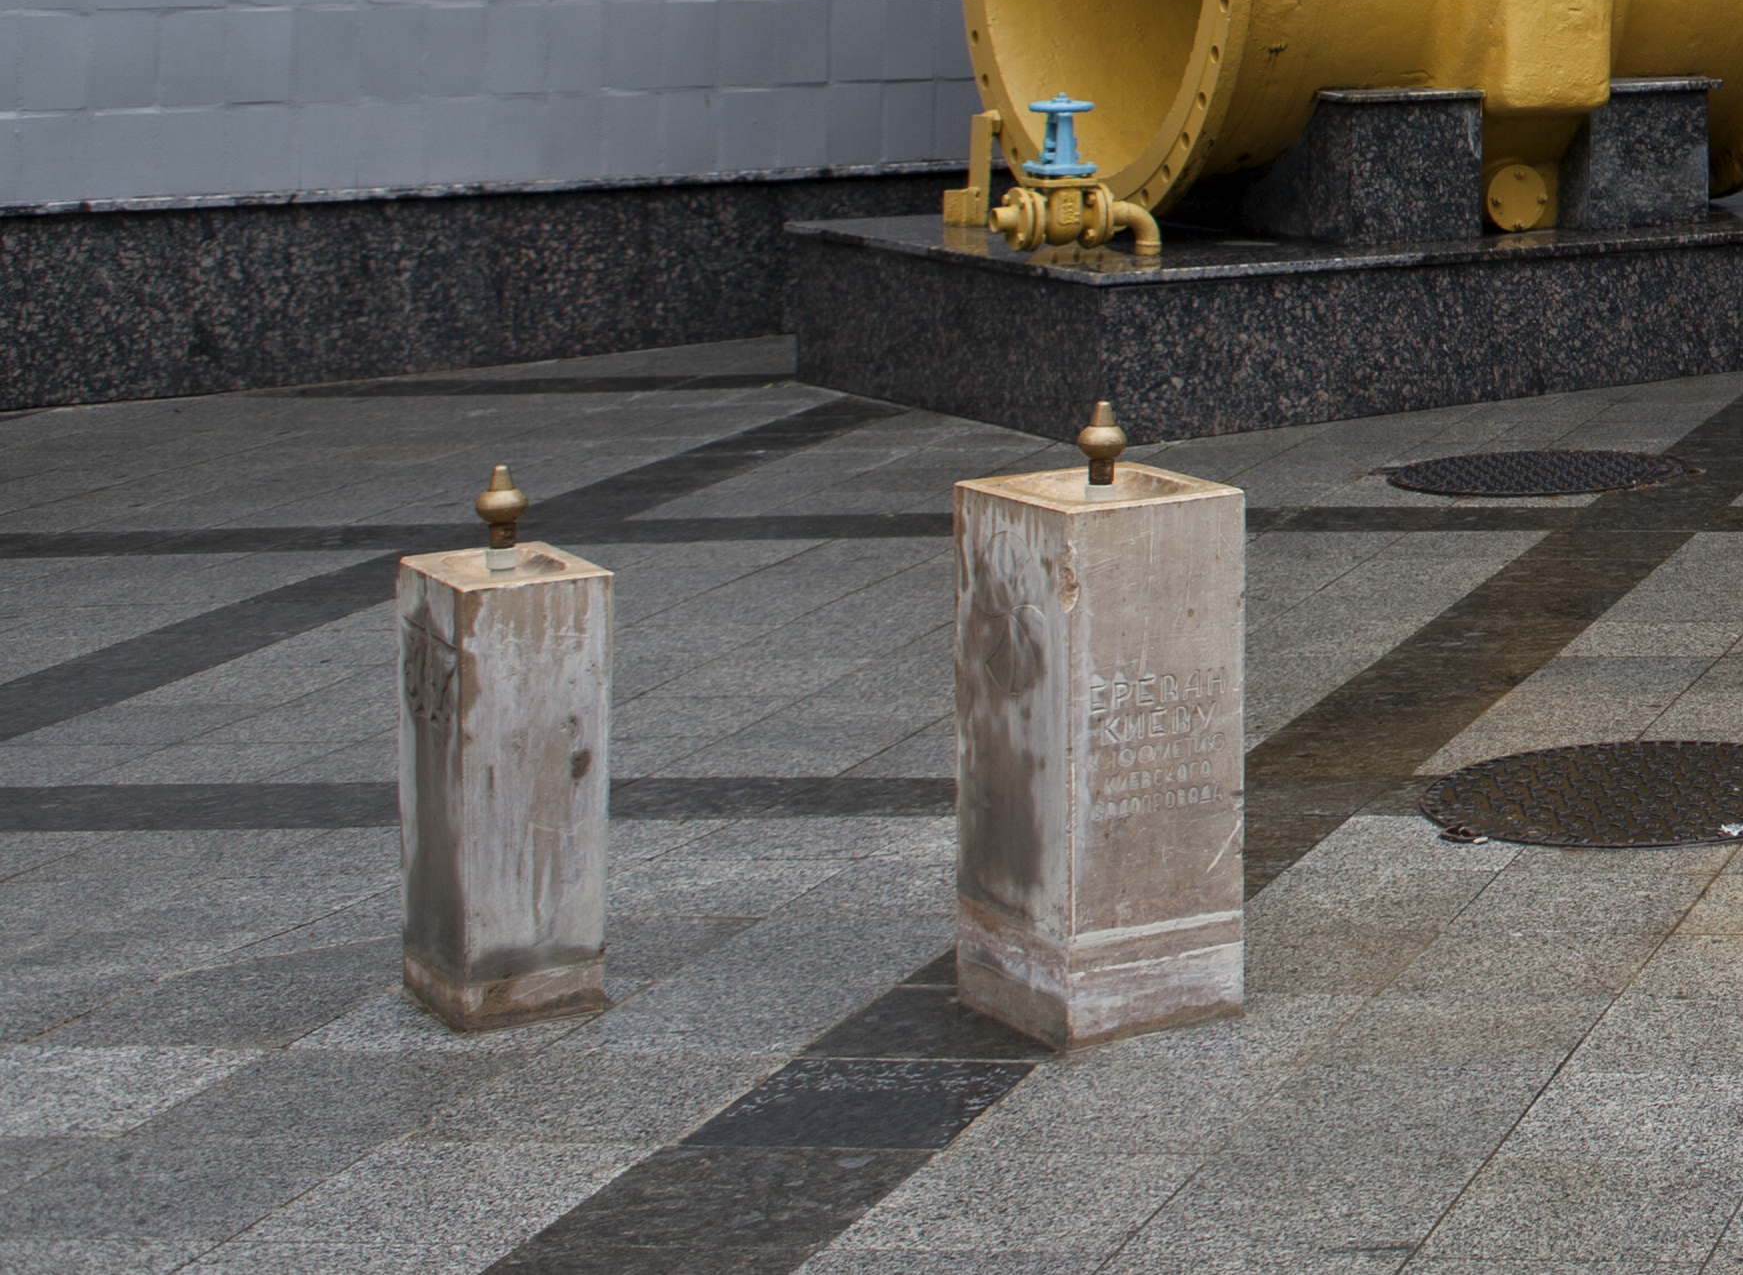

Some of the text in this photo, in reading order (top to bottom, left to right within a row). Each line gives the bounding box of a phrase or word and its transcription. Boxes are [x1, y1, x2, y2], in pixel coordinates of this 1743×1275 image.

[1090, 669, 1227, 713] ЕРЕВАН
[1100, 700, 1217, 745] КИЕВУ
[1104, 759, 1212, 796] КИЕВСКОГО
[1093, 782, 1223, 821] ВОДОПРОВОДА
